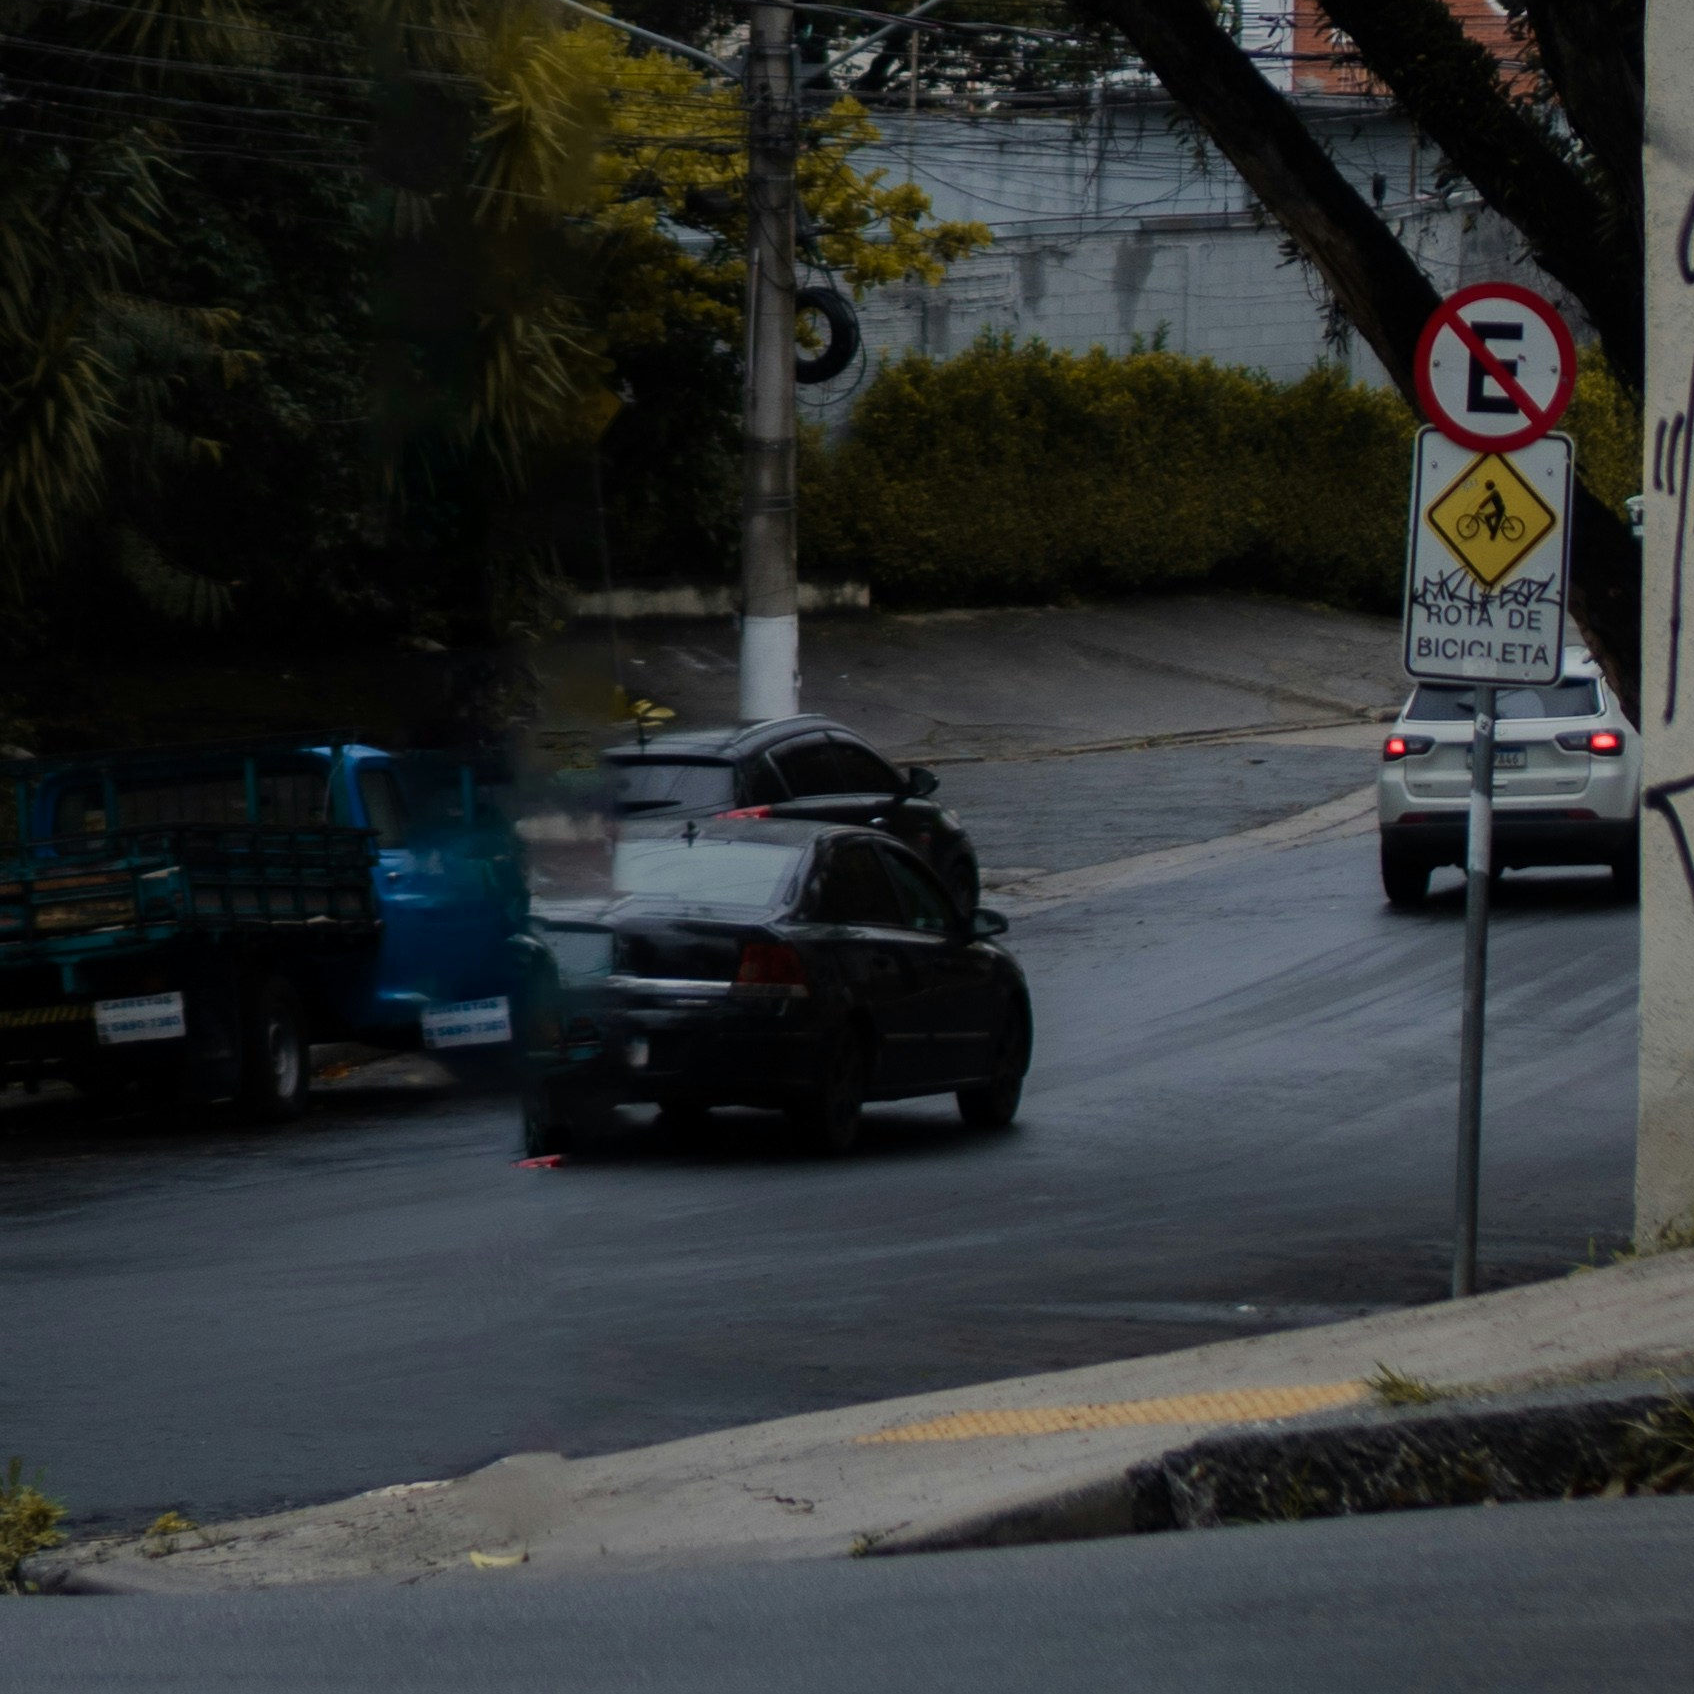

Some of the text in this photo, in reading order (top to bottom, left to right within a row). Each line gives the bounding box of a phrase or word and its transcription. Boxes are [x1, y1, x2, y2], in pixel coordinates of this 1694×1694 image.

[1467, 321, 1524, 415] E
[1427, 603, 1542, 631] ROTA DE
